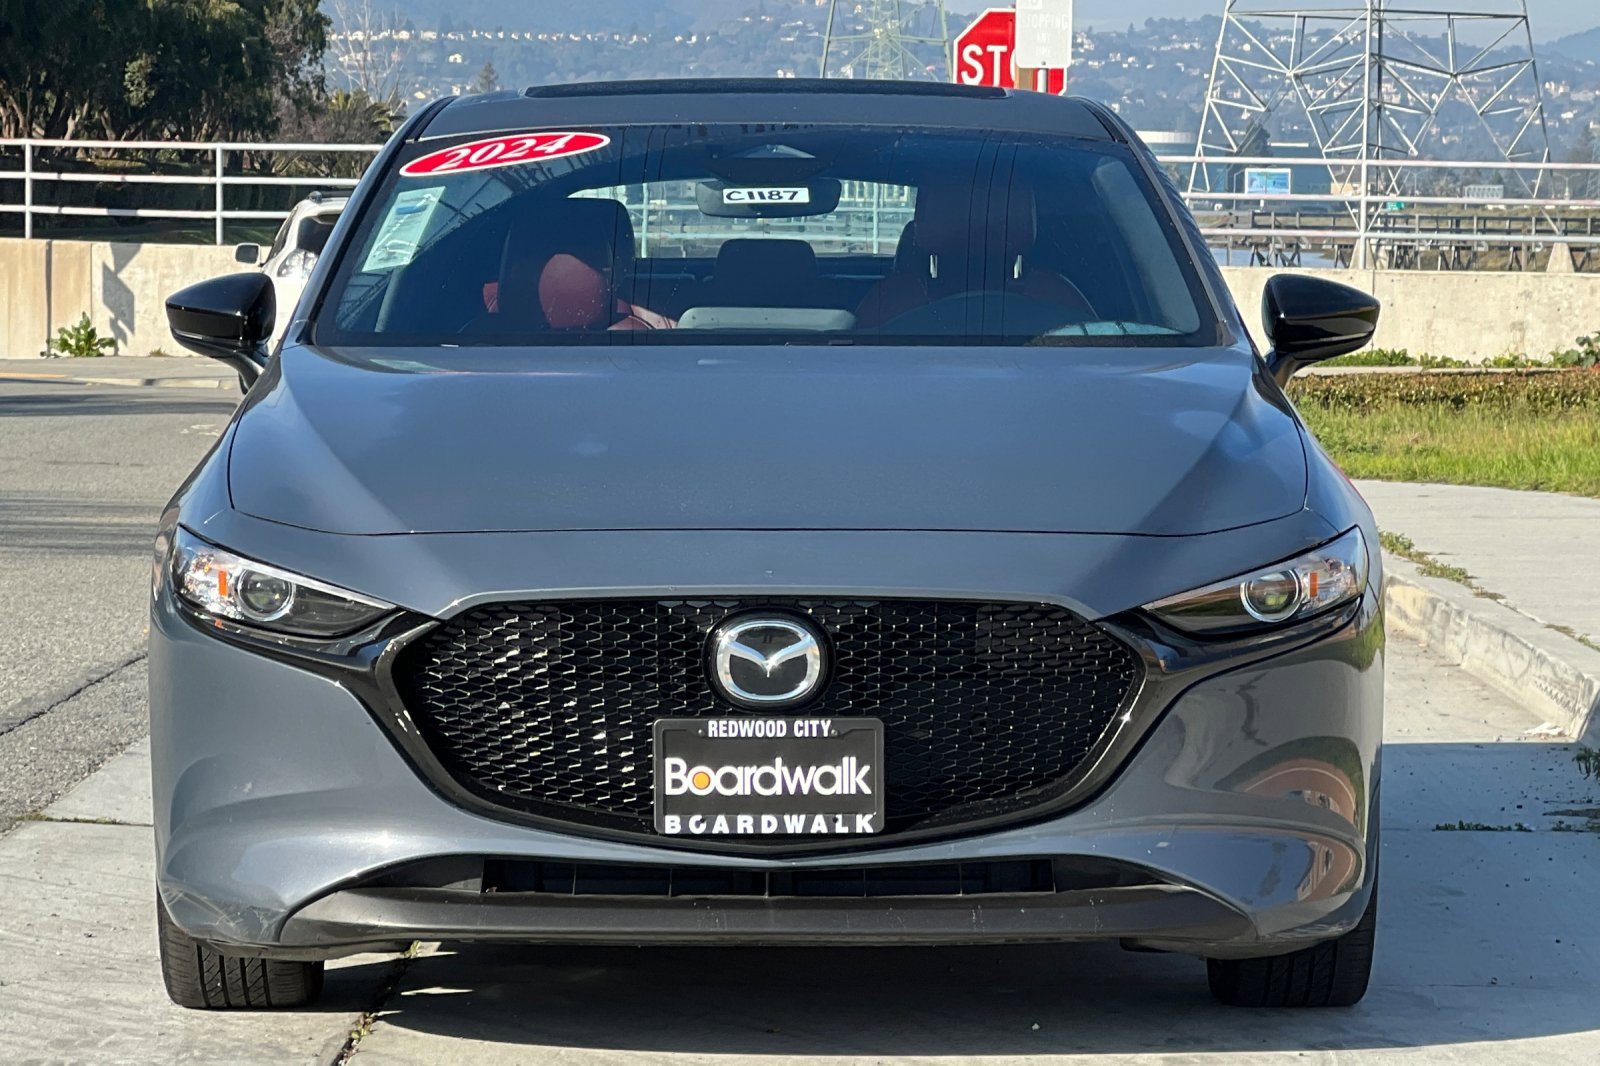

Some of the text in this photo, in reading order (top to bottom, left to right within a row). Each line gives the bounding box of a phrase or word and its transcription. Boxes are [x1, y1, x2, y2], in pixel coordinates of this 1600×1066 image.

[1021, 13, 1068, 30] TOPPING
[961, 44, 1015, 87] ST
[431, 134, 576, 172] 2024
[726, 190, 799, 201] C1187
[708, 720, 832, 737] REDWOOD CITY
[665, 756, 872, 796] Boardwalk
[665, 814, 874, 834] BOARDWALK
